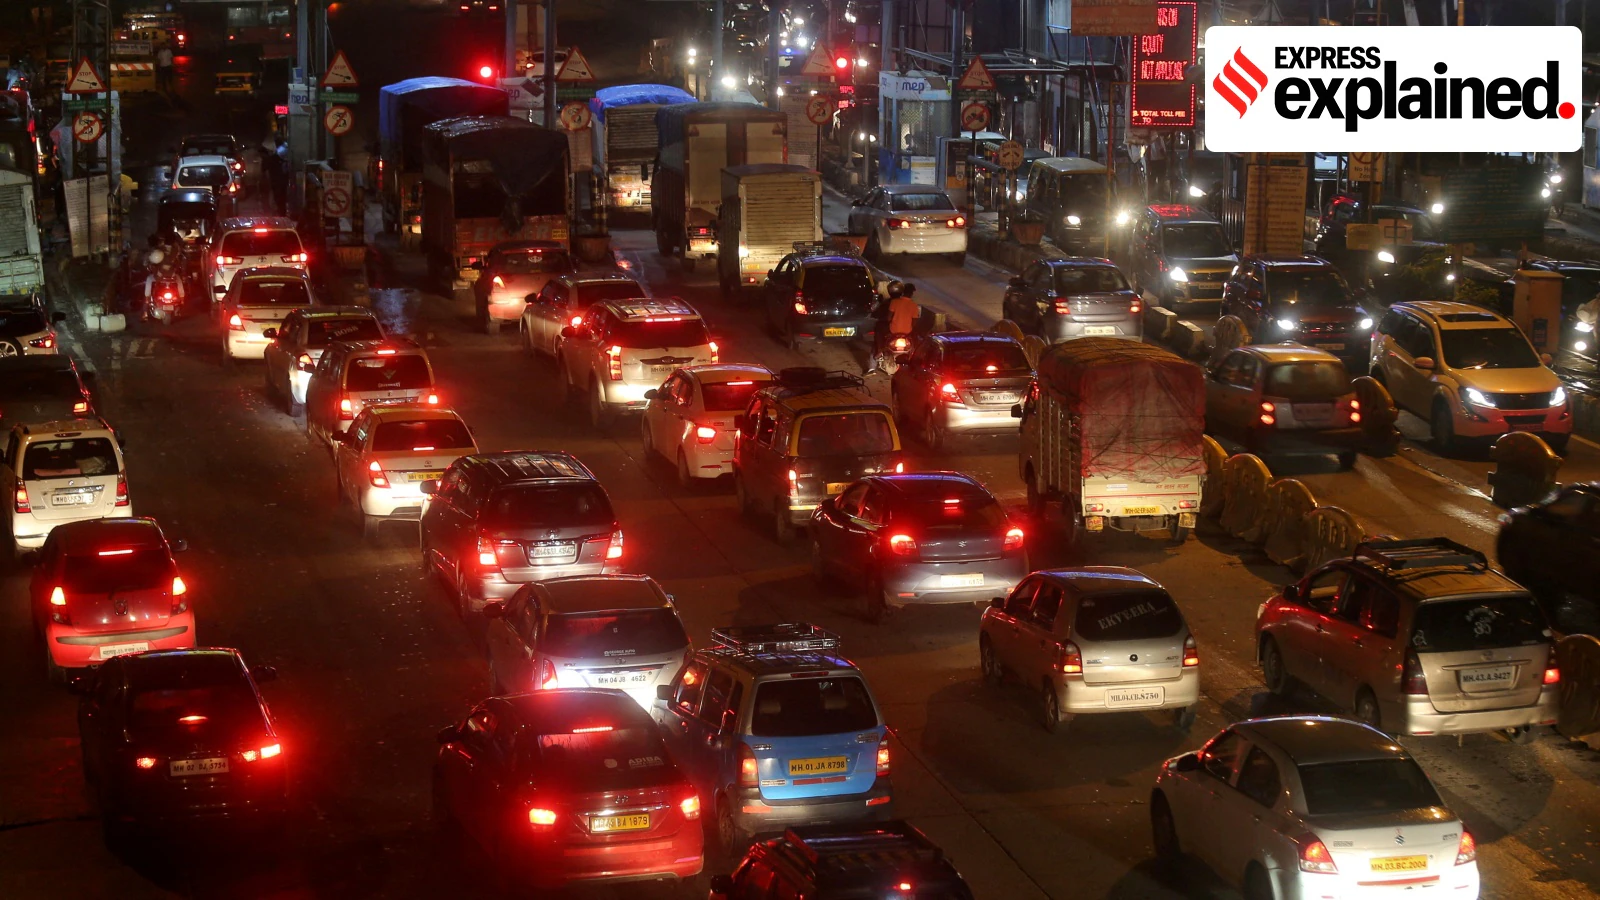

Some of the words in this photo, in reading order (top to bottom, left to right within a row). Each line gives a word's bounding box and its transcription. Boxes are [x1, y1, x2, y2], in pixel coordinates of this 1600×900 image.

[902, 81, 925, 94] mep
[1098, 601, 1156, 630] EKVEERA
[629, 756, 662, 765] ADIBA
